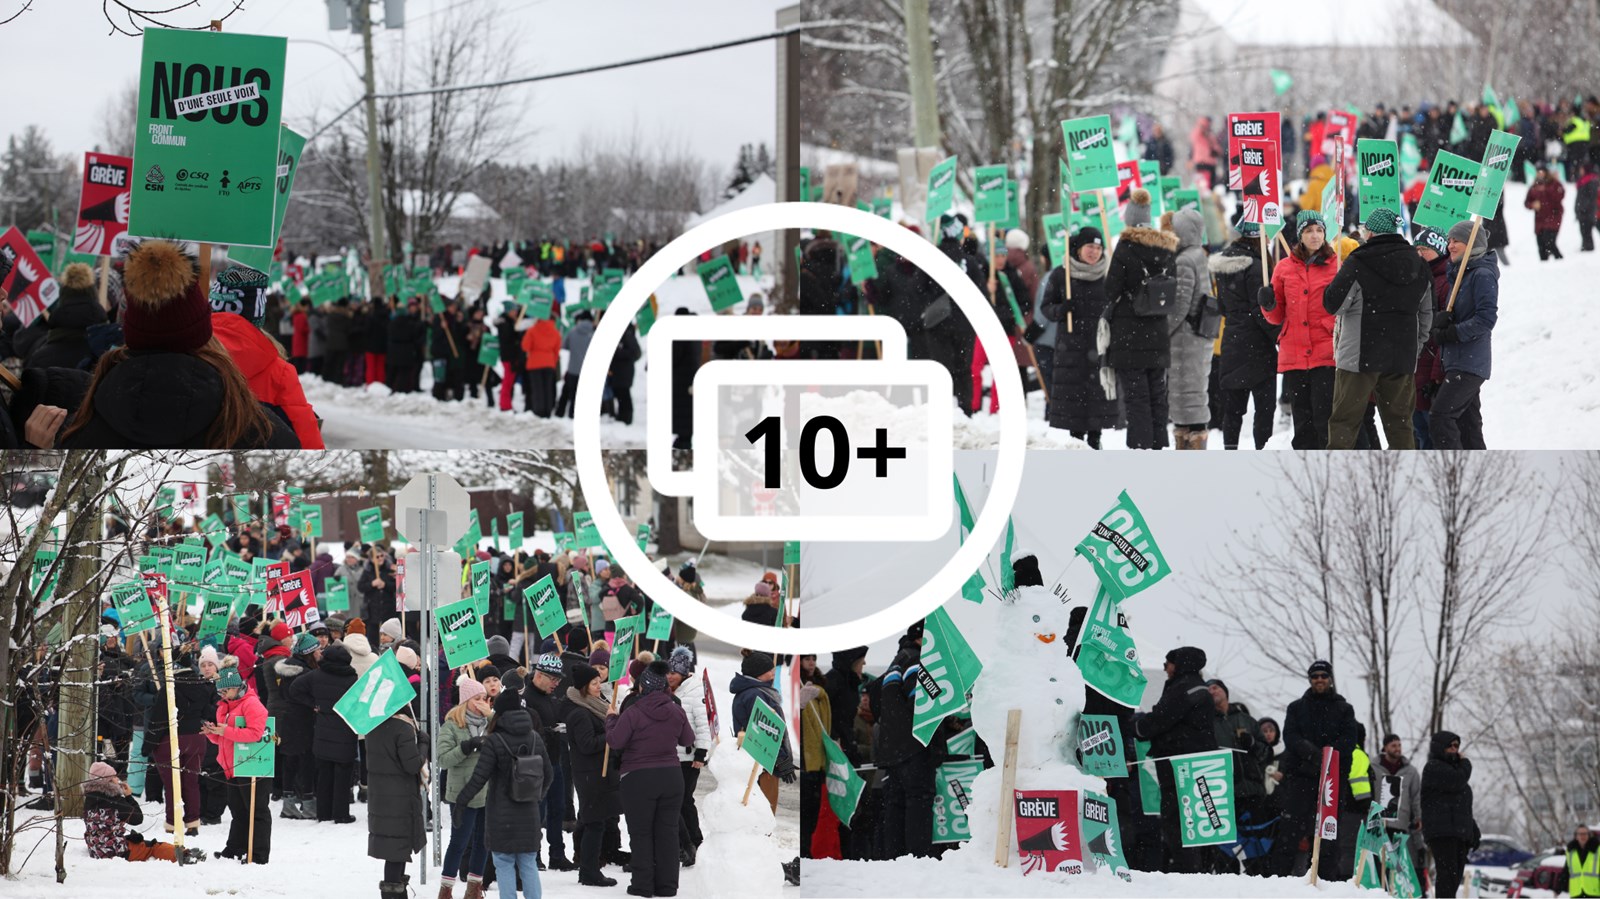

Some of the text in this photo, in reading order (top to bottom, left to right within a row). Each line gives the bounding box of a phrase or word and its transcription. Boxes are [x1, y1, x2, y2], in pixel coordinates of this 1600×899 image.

[150, 61, 271, 127] NOUS
[178, 85, 256, 112] D'UNE SEULE VOIX
[149, 124, 174, 135] FRONT
[1069, 127, 1109, 151] NOUS
[1234, 121, 1263, 136] GRÈVE
[152, 134, 187, 146] COMMUN
[1243, 149, 1263, 165] GRÈVE
[1361, 152, 1395, 177] NOUS
[1485, 143, 1512, 171] NOUS
[90, 165, 126, 186] GRÈVE
[190, 171, 209, 181] CSQ
[237, 181, 261, 191] APTS
[145, 183, 164, 191] CSN
[1091, 508, 1159, 587] OUS
[1112, 535, 1132, 555] SEULE
[1130, 551, 1147, 569] VOIX
[116, 587, 146, 608] NOUS
[529, 584, 555, 610] NOUS
[440, 607, 477, 634] NOUS
[1091, 623, 1112, 638] FRONT
[923, 677, 940, 697] VOIX
[753, 707, 781, 743] NOUS
[1080, 719, 1117, 756] OUS
[1019, 798, 1057, 818] GRÈVE
[1191, 757, 1231, 838] NOUS
[1085, 801, 1108, 823] GRÈVE
